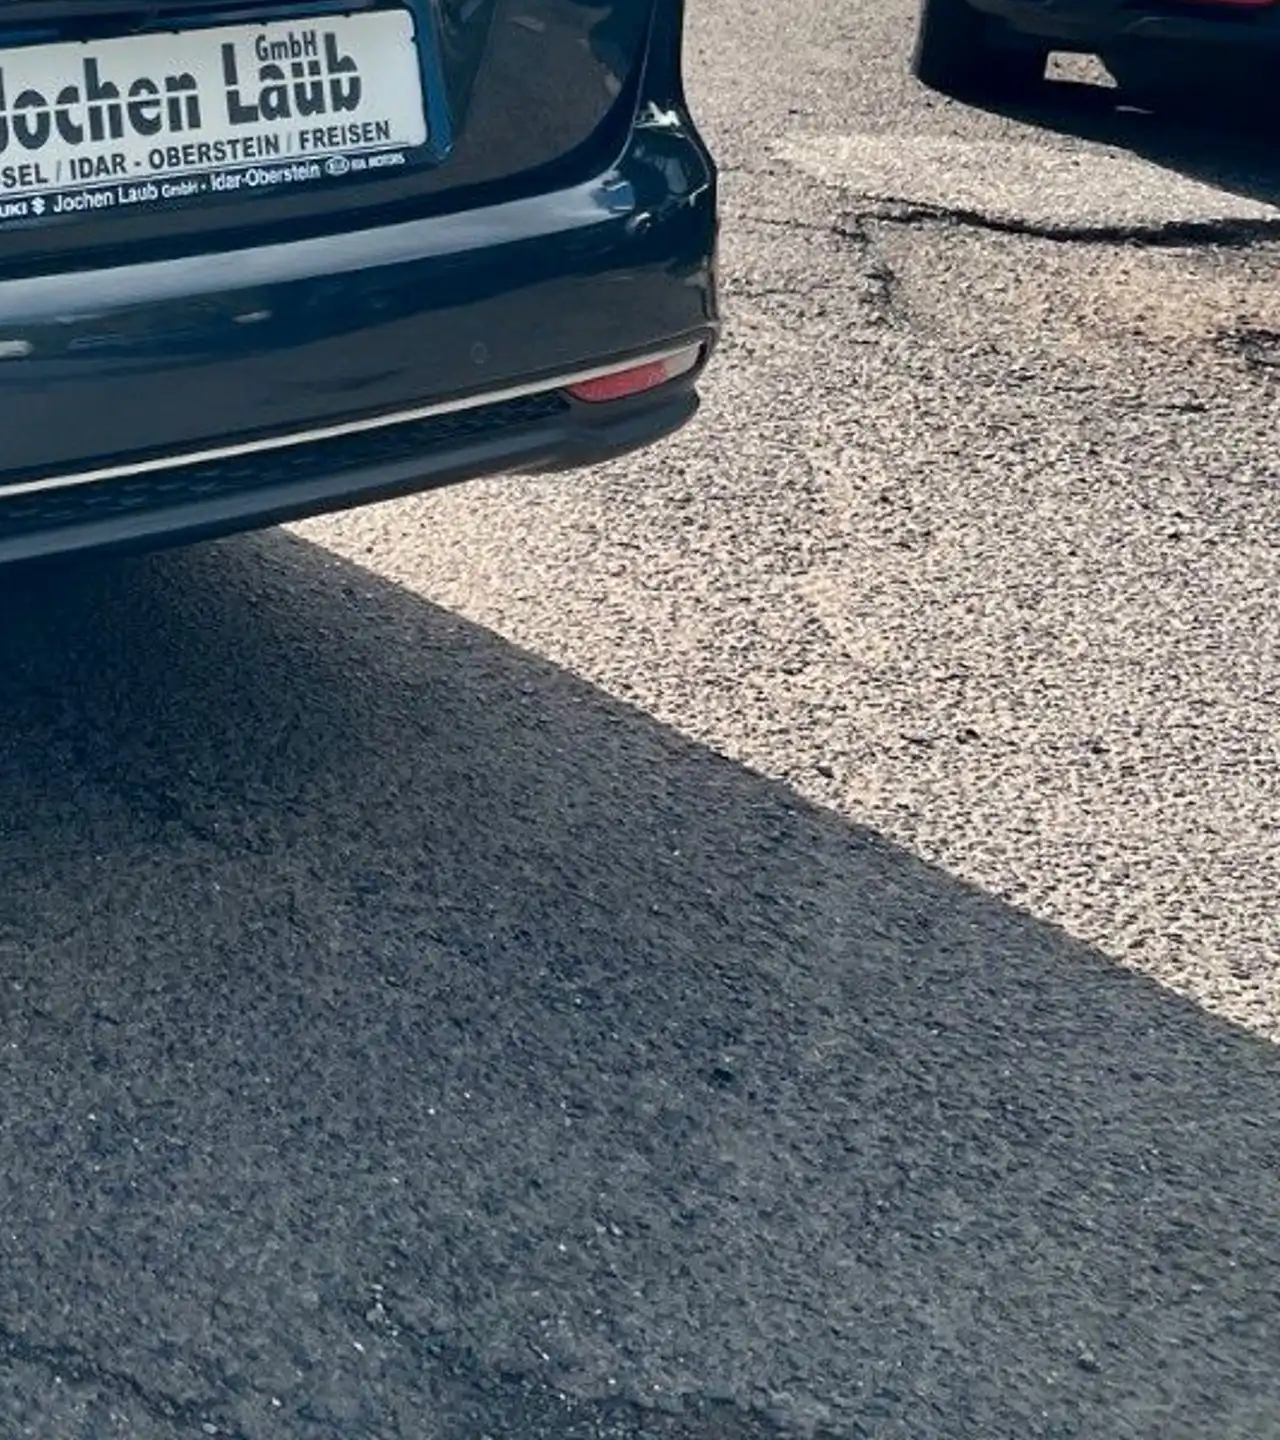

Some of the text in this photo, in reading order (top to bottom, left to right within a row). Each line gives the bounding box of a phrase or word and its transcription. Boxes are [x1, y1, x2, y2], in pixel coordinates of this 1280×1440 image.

[255, 30, 318, 61] GmbH
[221, 32, 362, 126] Laub
[69, 152, 127, 181] IDAR
[148, 133, 281, 171] OBERSTEIN
[298, 119, 391, 150] FREISEN
[53, 189, 114, 213] Jochen
[117, 182, 159, 205] Laub
[210, 161, 321, 191] Idar-Oberstein
